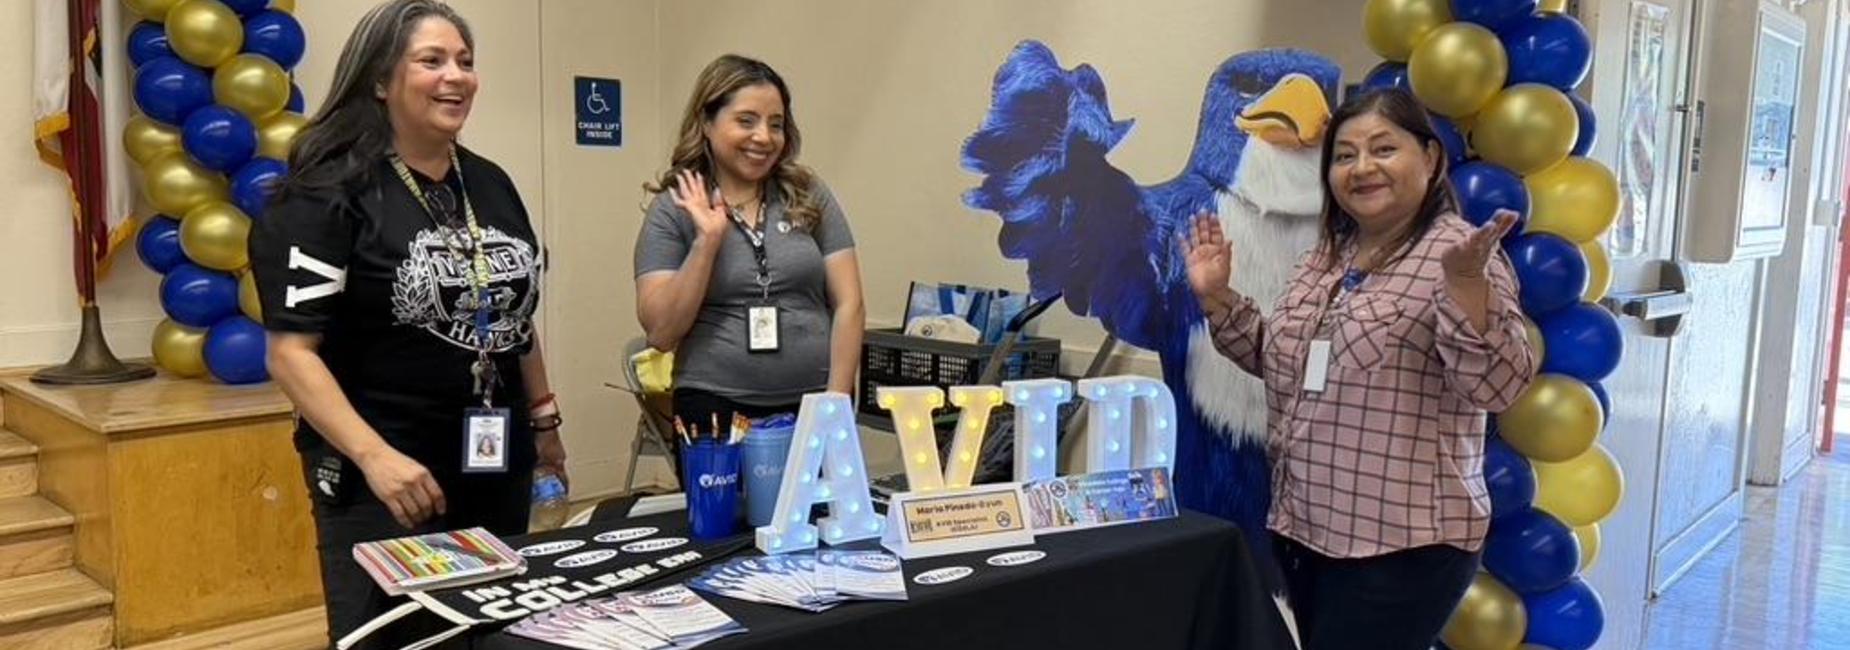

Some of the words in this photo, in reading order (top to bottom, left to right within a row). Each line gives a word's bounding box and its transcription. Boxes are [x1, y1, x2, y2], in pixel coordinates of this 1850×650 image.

[578, 121, 602, 129] CHAIR
[585, 131, 613, 139] INSIDE
[285, 246, 347, 308] V
[756, 376, 1177, 554] AVID
[463, 585, 511, 603] IN
[480, 564, 659, 620] COLLEGE
